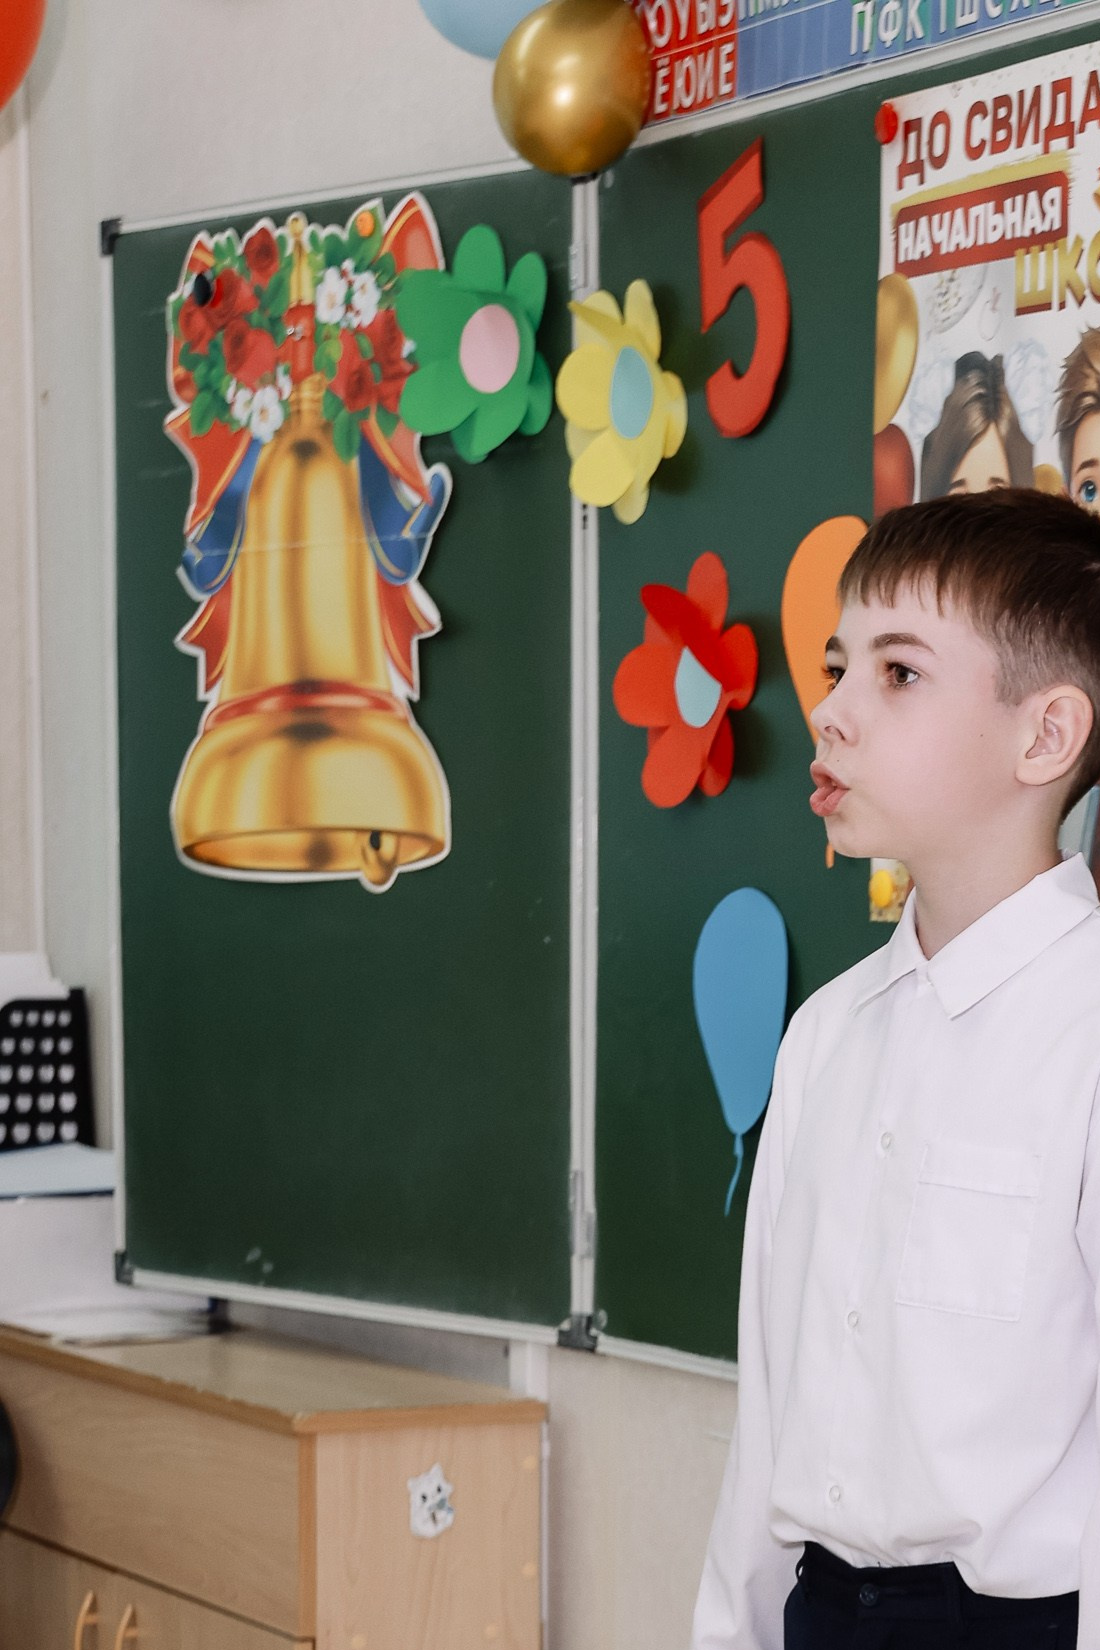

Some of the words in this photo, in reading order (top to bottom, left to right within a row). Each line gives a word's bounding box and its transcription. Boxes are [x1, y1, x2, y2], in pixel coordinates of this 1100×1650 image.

[897, 110, 951, 191] ДО
[898, 186, 1063, 264] НАЧАЛЬНАЯ
[697, 136, 791, 438] 5
